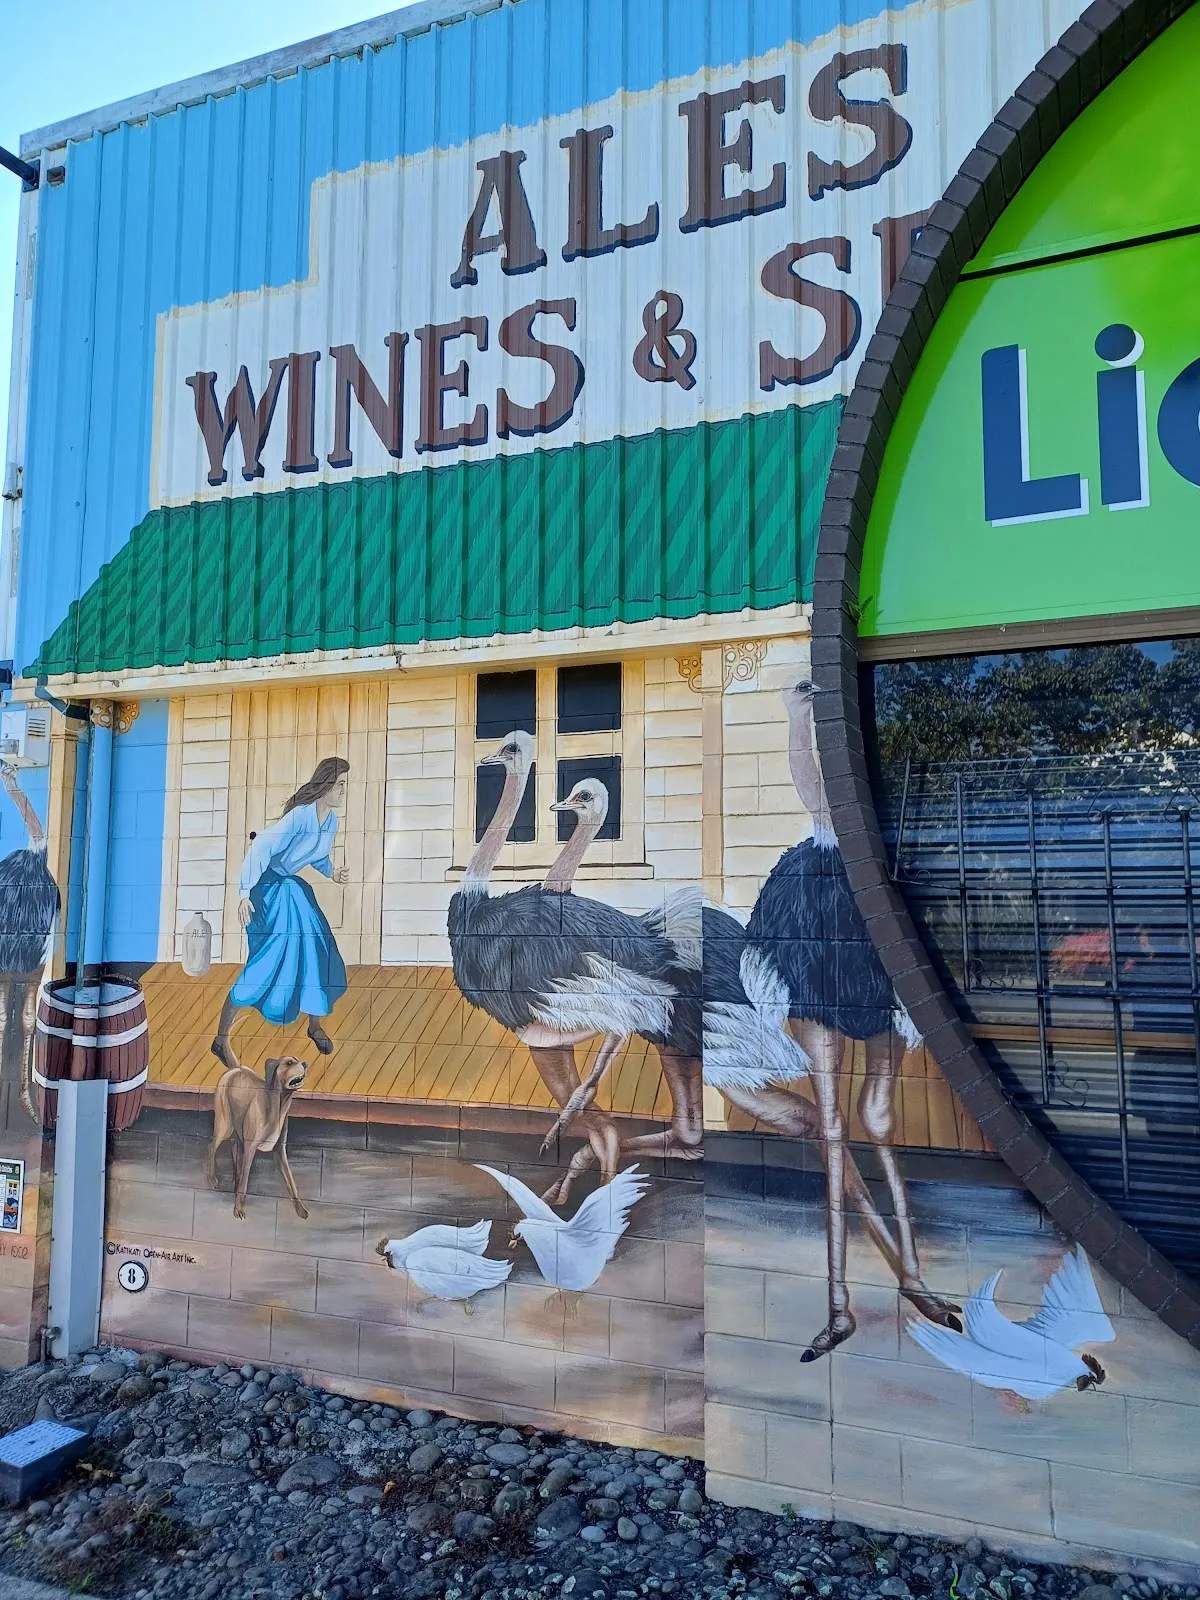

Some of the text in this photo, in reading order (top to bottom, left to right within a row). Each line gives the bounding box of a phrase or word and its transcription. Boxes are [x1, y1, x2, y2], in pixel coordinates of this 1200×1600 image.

[450, 43, 913, 289] ALES
[185, 298, 586, 487] WINES
[632, 289, 697, 391] &
[127, 1267, 136, 1285] 8
